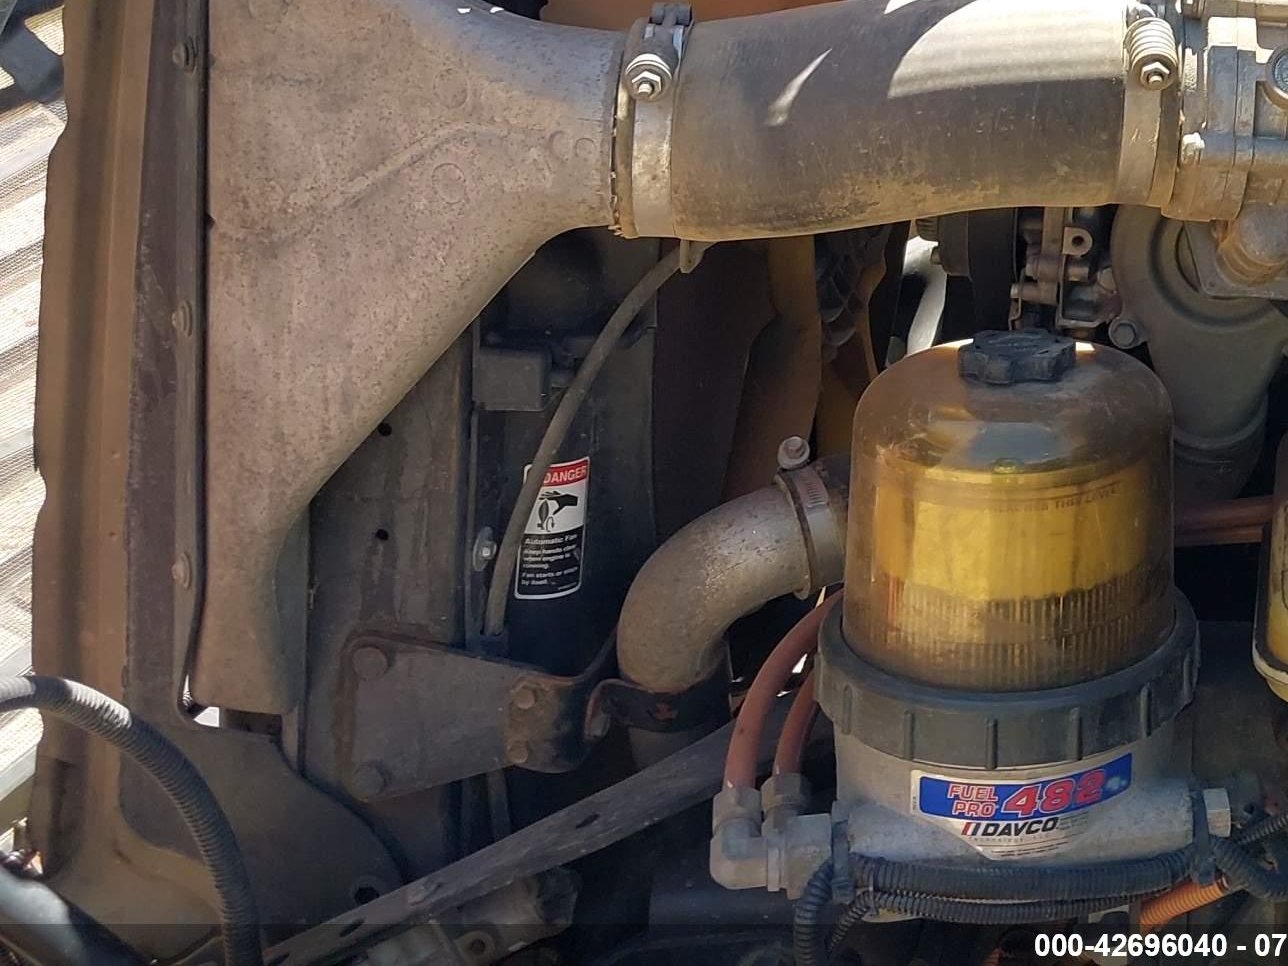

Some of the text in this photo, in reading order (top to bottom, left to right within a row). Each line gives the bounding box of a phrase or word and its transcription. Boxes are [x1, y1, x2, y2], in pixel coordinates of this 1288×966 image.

[544, 466, 586, 483] DANGER
[525, 536, 564, 545] Automatic
[947, 784, 999, 801] FUEL
[1001, 769, 1106, 818] 482
[952, 801, 996, 818] PRO
[982, 817, 1059, 837] DAVCO
